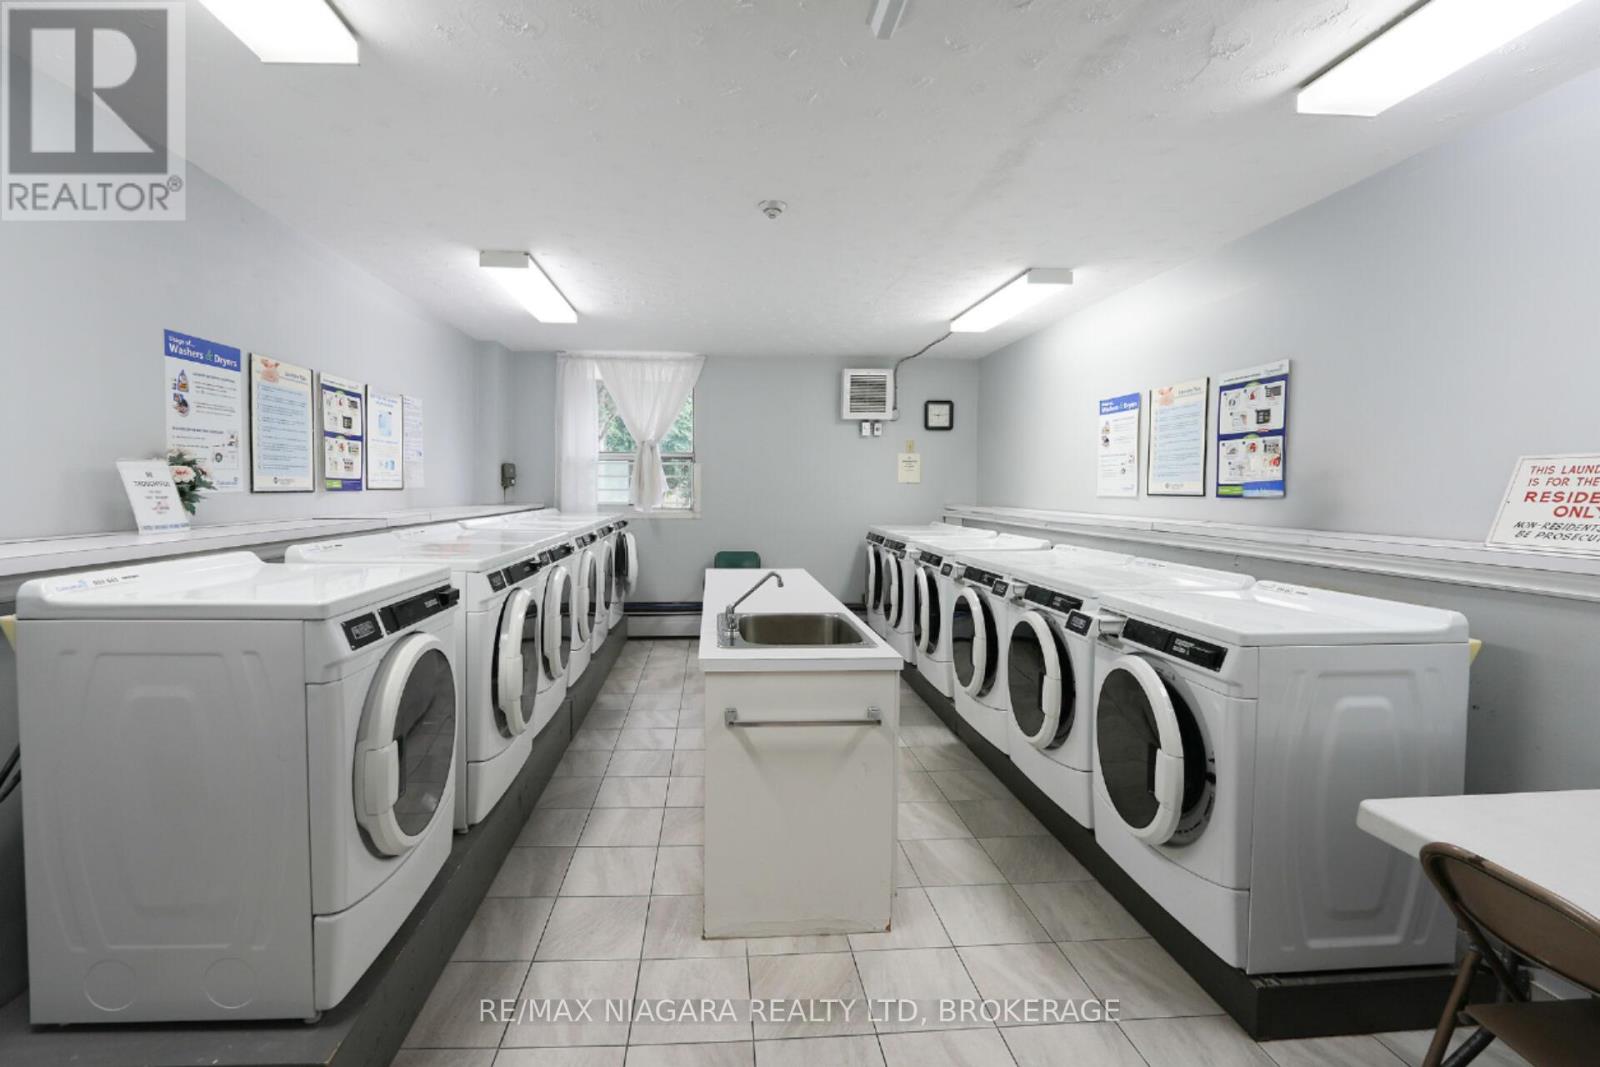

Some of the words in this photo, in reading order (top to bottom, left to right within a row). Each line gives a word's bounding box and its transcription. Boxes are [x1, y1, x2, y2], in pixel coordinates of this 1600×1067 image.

[168, 343, 204, 360] Washers
[204, 350, 213, 361] &
[214, 354, 238, 367] Dryers
[1530, 465, 1556, 475] THIS
[1528, 478, 1540, 487] IS
[1546, 477, 1571, 487] FOR
[1577, 476, 1600, 486] THE
[1524, 491, 1600, 503] RESIDE
[1515, 530, 1532, 539] BE
